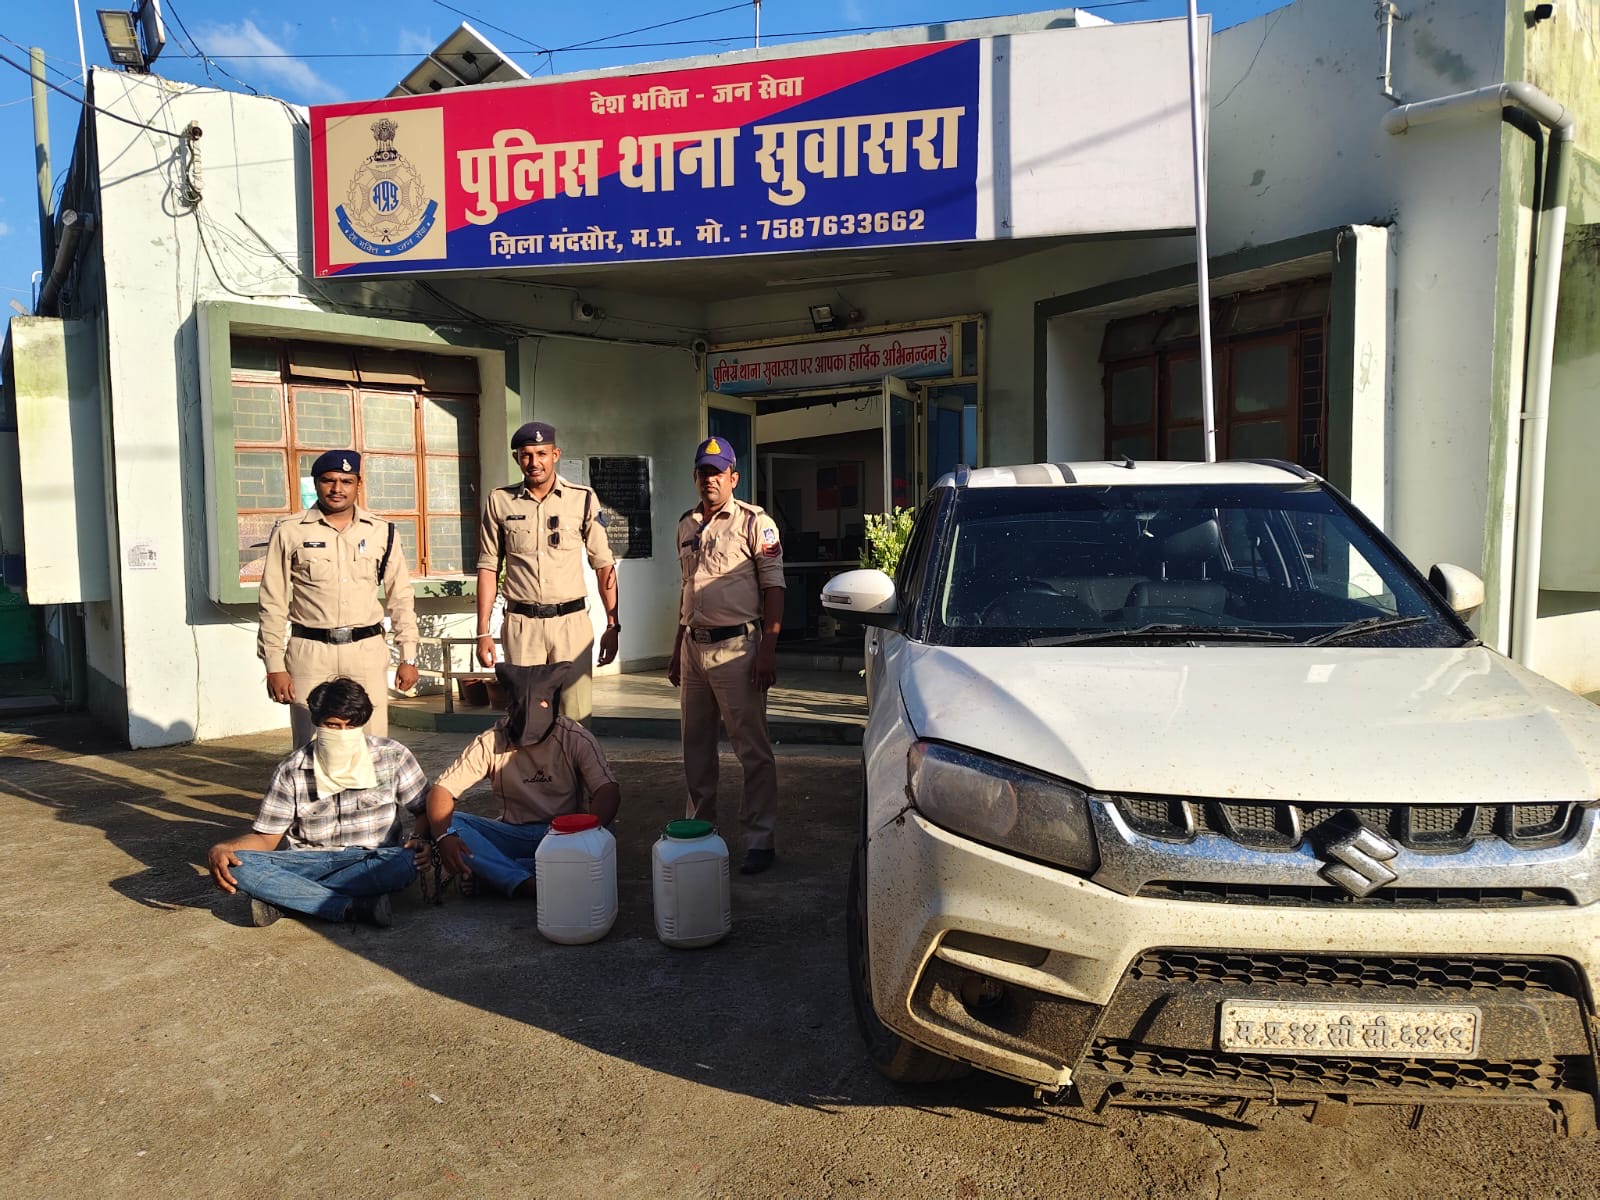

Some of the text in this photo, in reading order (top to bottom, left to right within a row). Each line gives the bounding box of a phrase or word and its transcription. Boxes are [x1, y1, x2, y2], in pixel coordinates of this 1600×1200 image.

[590, 91, 626, 115] देश
[632, 85, 689, 111] भक्ति
[711, 81, 752, 103] जन
[758, 74, 804, 99] सेवा
[457, 105, 966, 226] पुलिस थाना सुवासरा
[549, 225, 624, 254] मंदसौर,
[630, 227, 682, 248] म.प्र.
[695, 218, 731, 244] मो.
[756, 208, 925, 240] 7587633662
[712, 336, 948, 390] पुलिस थाना सुवासरा पर आपका हार्दिक अभिनन्दन है
